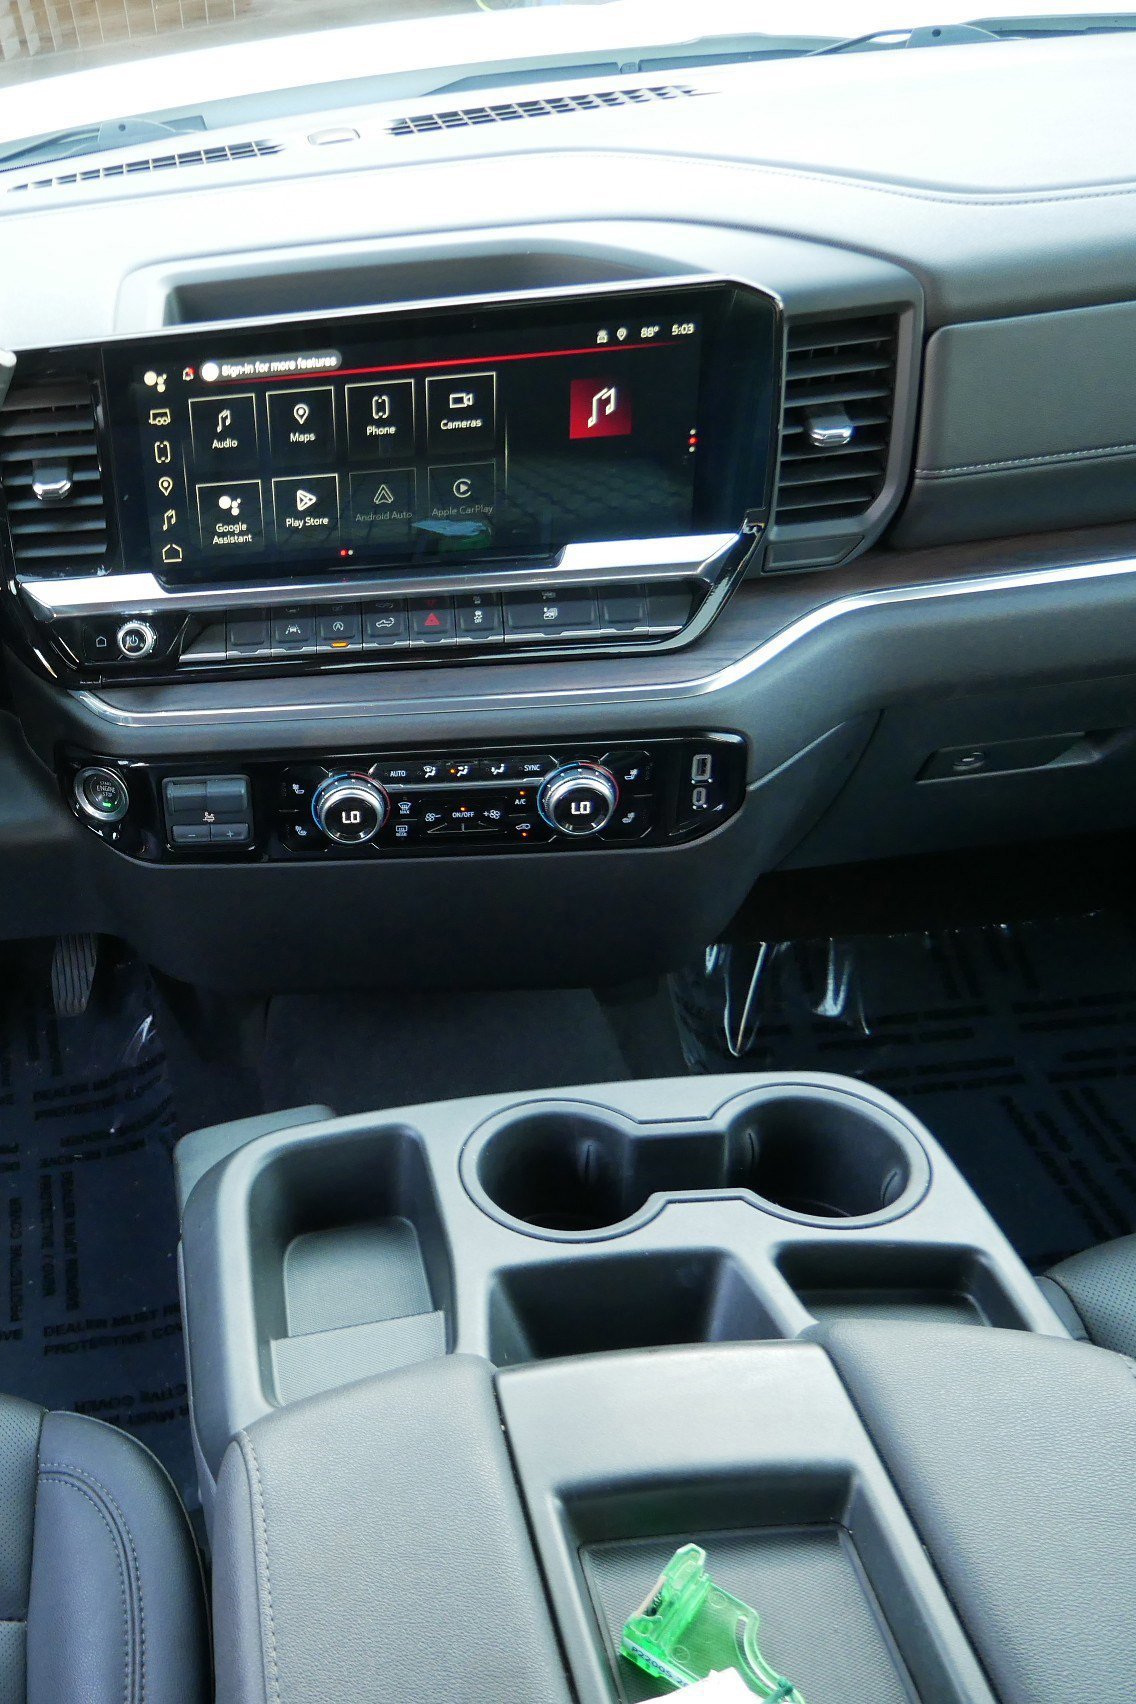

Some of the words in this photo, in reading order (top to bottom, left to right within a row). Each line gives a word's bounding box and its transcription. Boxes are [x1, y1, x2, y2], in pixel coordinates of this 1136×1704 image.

[671, 323, 695, 335] 5:03
[255, 362, 269, 374] for
[270, 360, 296, 373] more
[297, 356, 338, 370] features
[440, 418, 483, 430] Cameras
[366, 425, 396, 436] Phone
[290, 432, 316, 444] Maps
[212, 439, 238, 450] Audio
[355, 511, 390, 522] Android
[391, 510, 413, 519] Auto
[431, 507, 458, 517] Apple
[459, 504, 494, 515] CarPlay
[216, 522, 247, 534] Google
[286, 518, 304, 529] Play
[305, 517, 329, 527] Store
[212, 533, 253, 545] Assistant
[389, 770, 407, 778] AUTO
[524, 764, 540, 772] SYNC
[452, 811, 474, 819] ON/OFF
[630, 1646, 673, 1678] P22005
